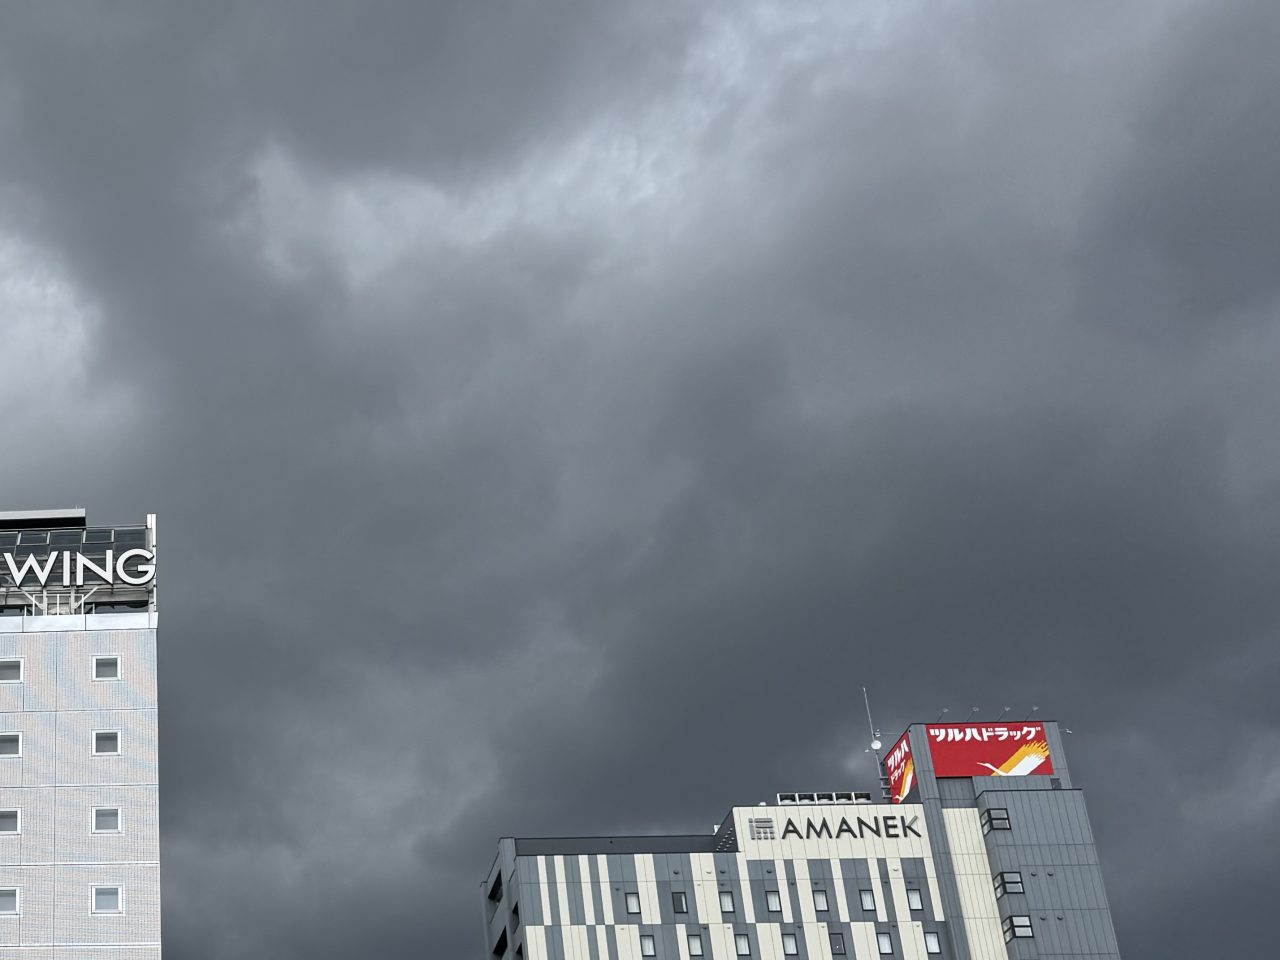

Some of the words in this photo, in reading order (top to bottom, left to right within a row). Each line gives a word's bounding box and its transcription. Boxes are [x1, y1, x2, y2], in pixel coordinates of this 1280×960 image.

[929, 725, 1042, 743] ツルハドラッグ
[886, 739, 910, 770] ツルハ
[889, 759, 907, 786] ドラッグ
[780, 814, 923, 841] AMANEK
